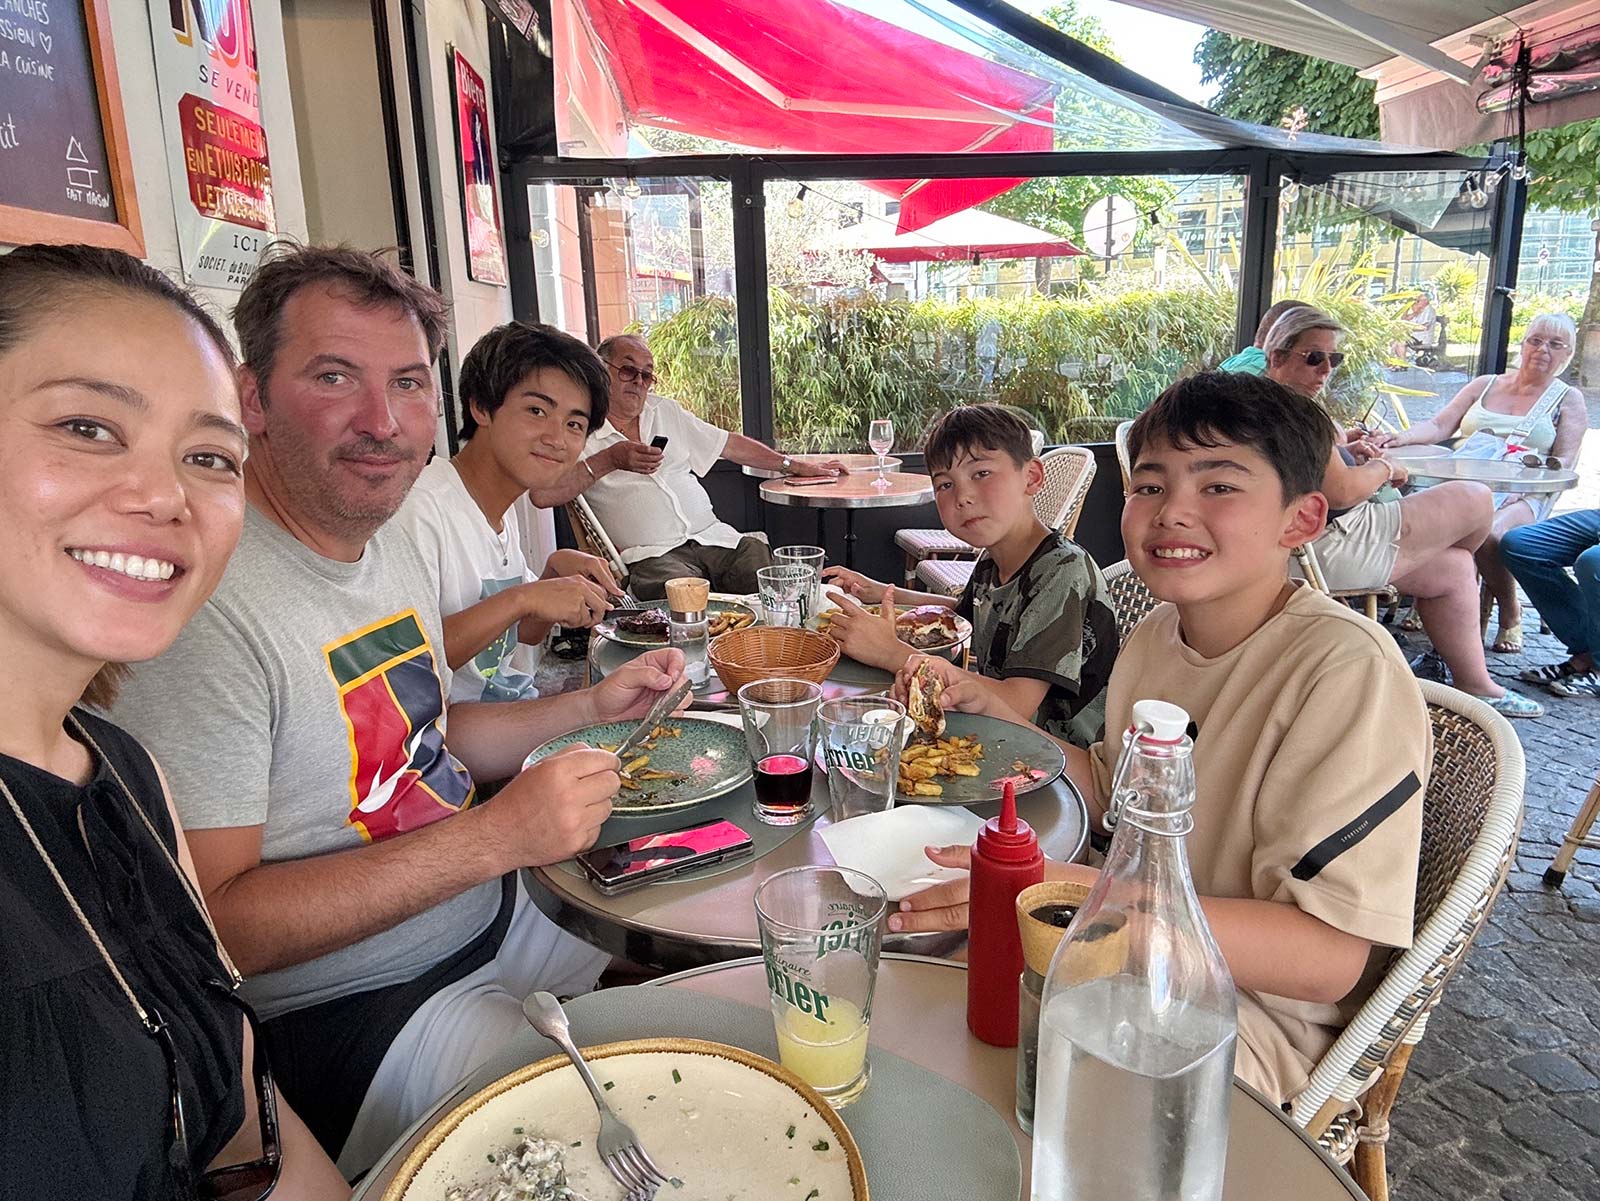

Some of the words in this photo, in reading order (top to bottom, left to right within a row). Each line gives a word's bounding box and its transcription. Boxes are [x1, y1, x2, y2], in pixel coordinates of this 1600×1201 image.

[199, 64, 219, 89] SE
[187, 145, 205, 174] EN
[205, 143, 242, 185] ETUIS
[233, 234, 258, 252] ICI
